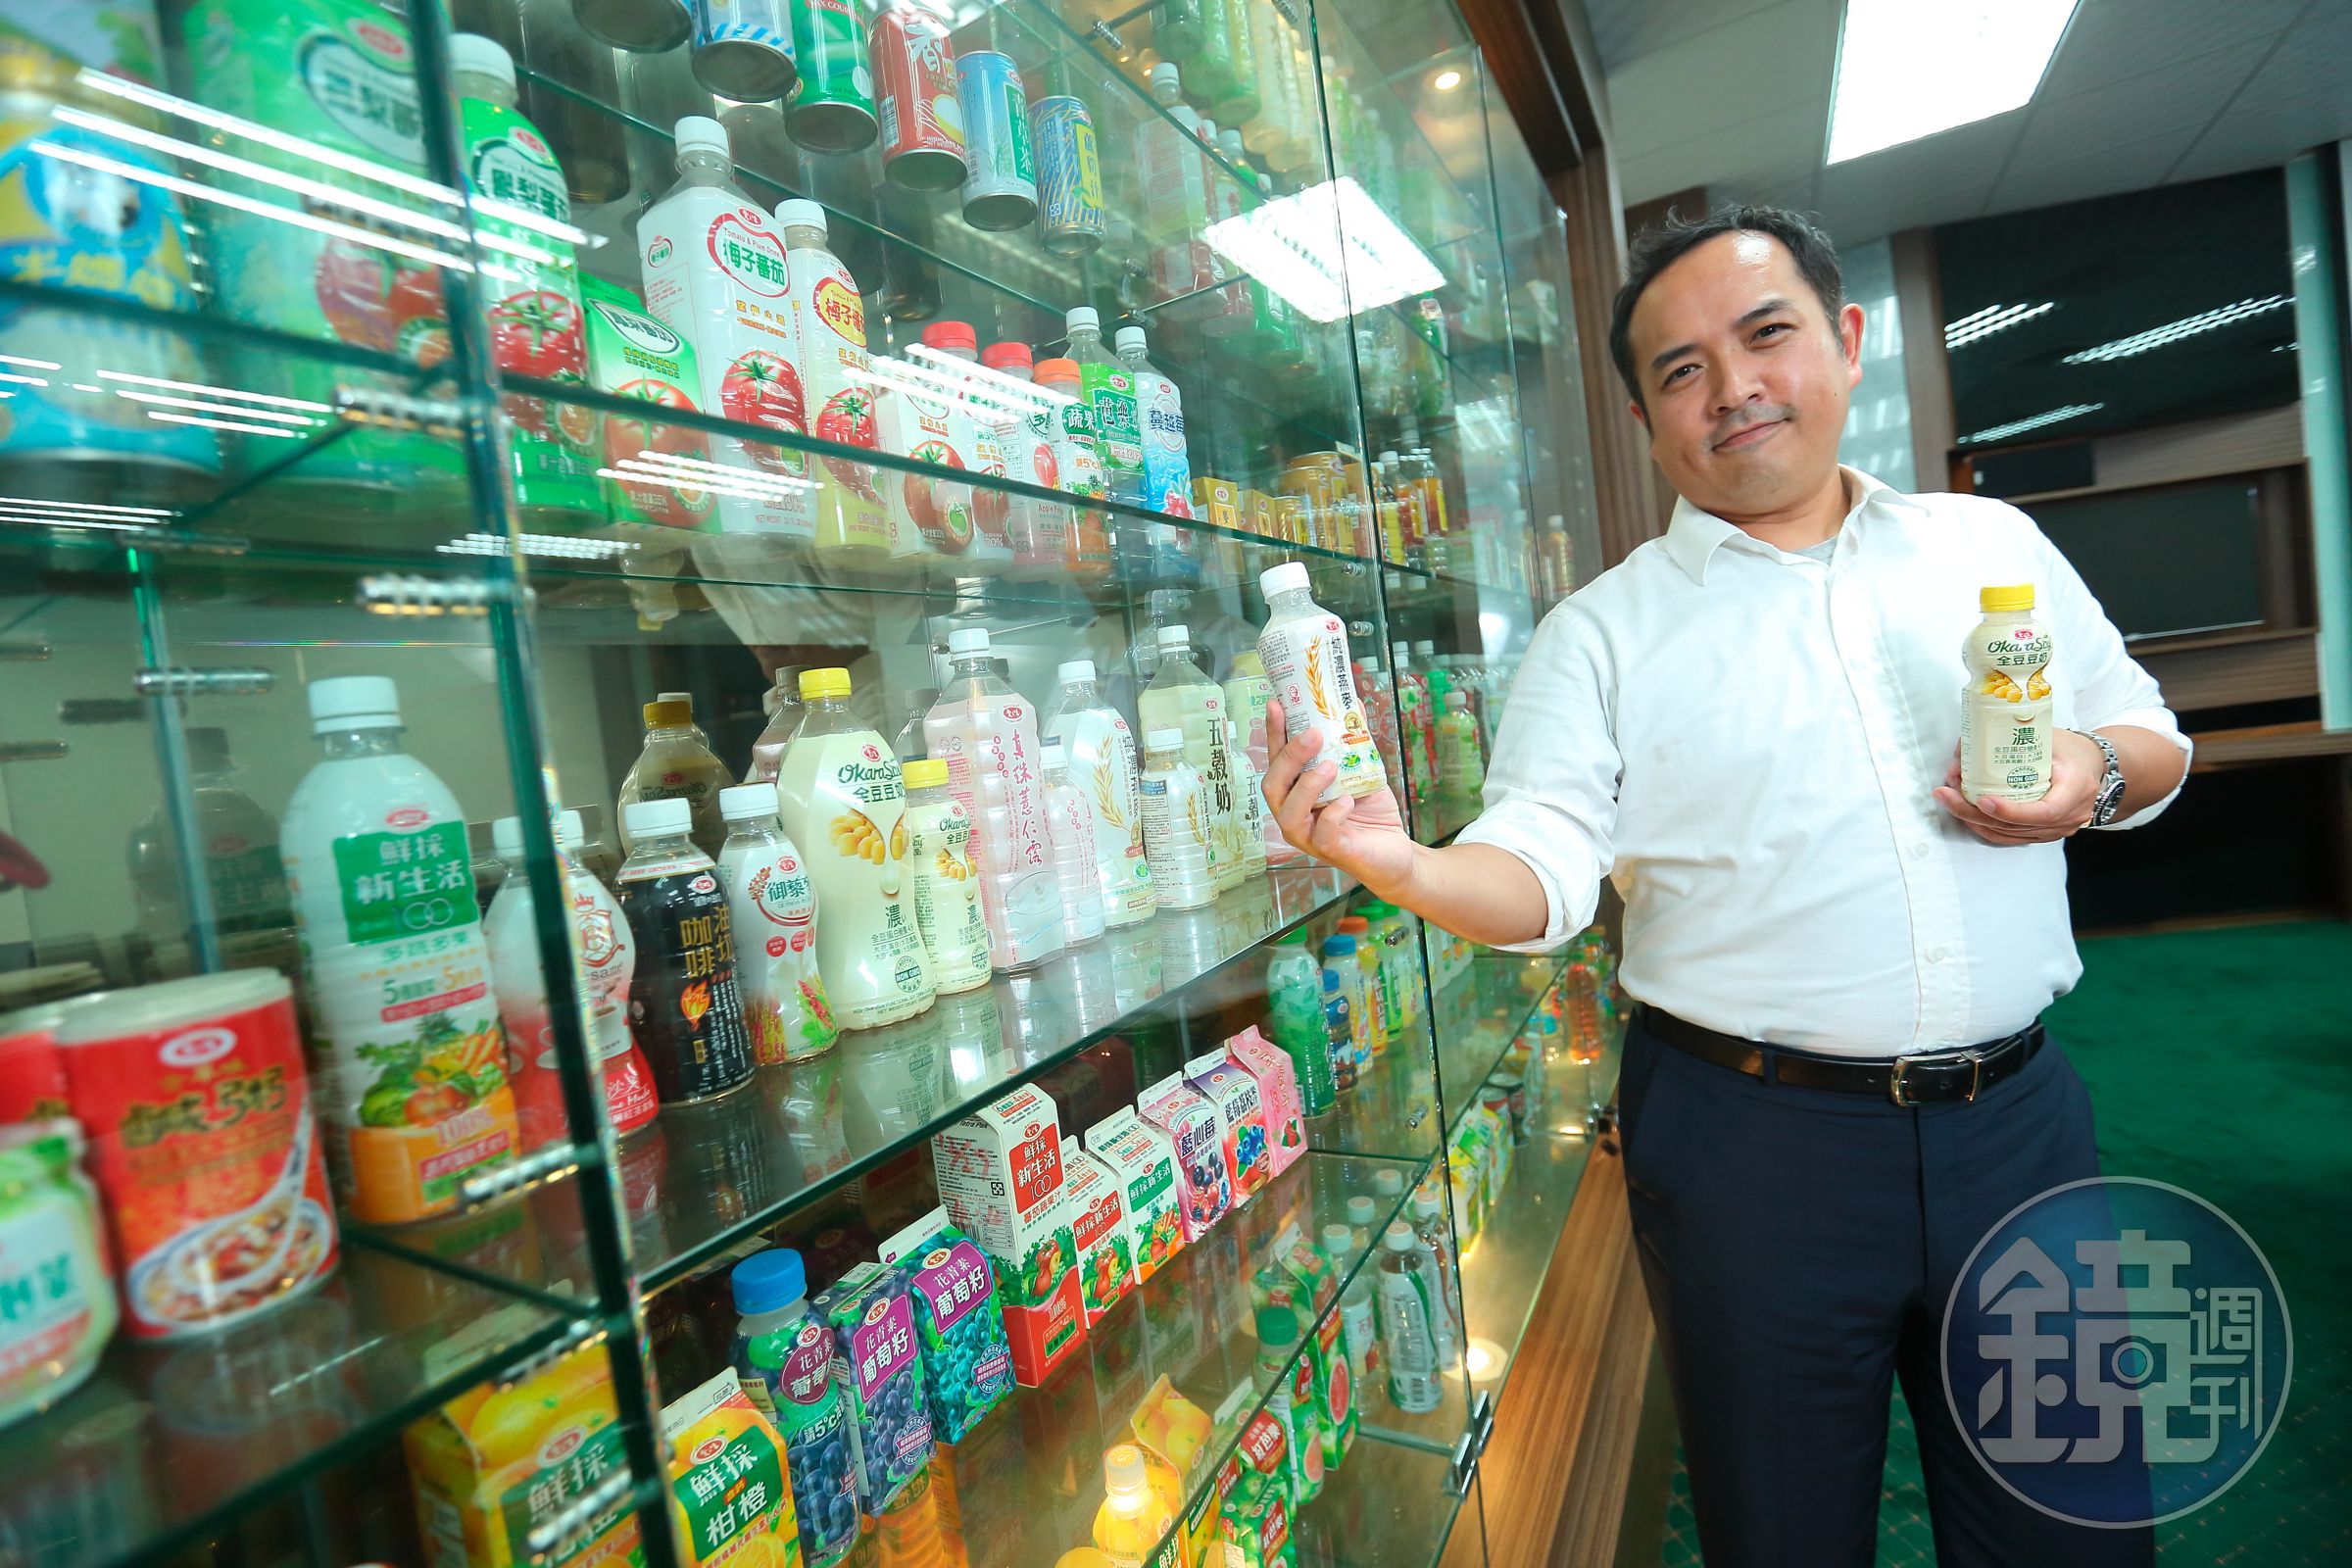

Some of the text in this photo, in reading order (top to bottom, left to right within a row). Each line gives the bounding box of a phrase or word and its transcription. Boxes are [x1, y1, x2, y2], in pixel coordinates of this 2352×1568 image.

[1012, 93, 1032, 172] 青草茶
[723, 227, 746, 243] Tomato
[752, 239, 766, 252] Plum
[1996, 652, 2049, 667] 全豆豆奶
[2008, 775, 2024, 784] NON
[379, 833, 445, 865] 鮮採
[355, 859, 466, 905] 新生活
[679, 914, 716, 980] 咖啡
[896, 972, 909, 982] NON
[1016, 1150, 1057, 1189] 新生活
[1024, 1139, 1048, 1163] 鮮採
[1031, 1175, 1053, 1201] 100
[1130, 1162, 1172, 1201] 鮮採新生活
[1075, 1197, 1120, 1239] 鮮採新生活
[934, 1256, 972, 1290] 花青素
[934, 1264, 986, 1320] 葡萄籽
[865, 1315, 899, 1352] 花青素
[798, 1336, 833, 1372] 花青素
[860, 1326, 910, 1388] 葡萄籽
[527, 1442, 610, 1524] 鮮採
[689, 1443, 759, 1507] 鮮採
[706, 1481, 768, 1547] 柑橙
